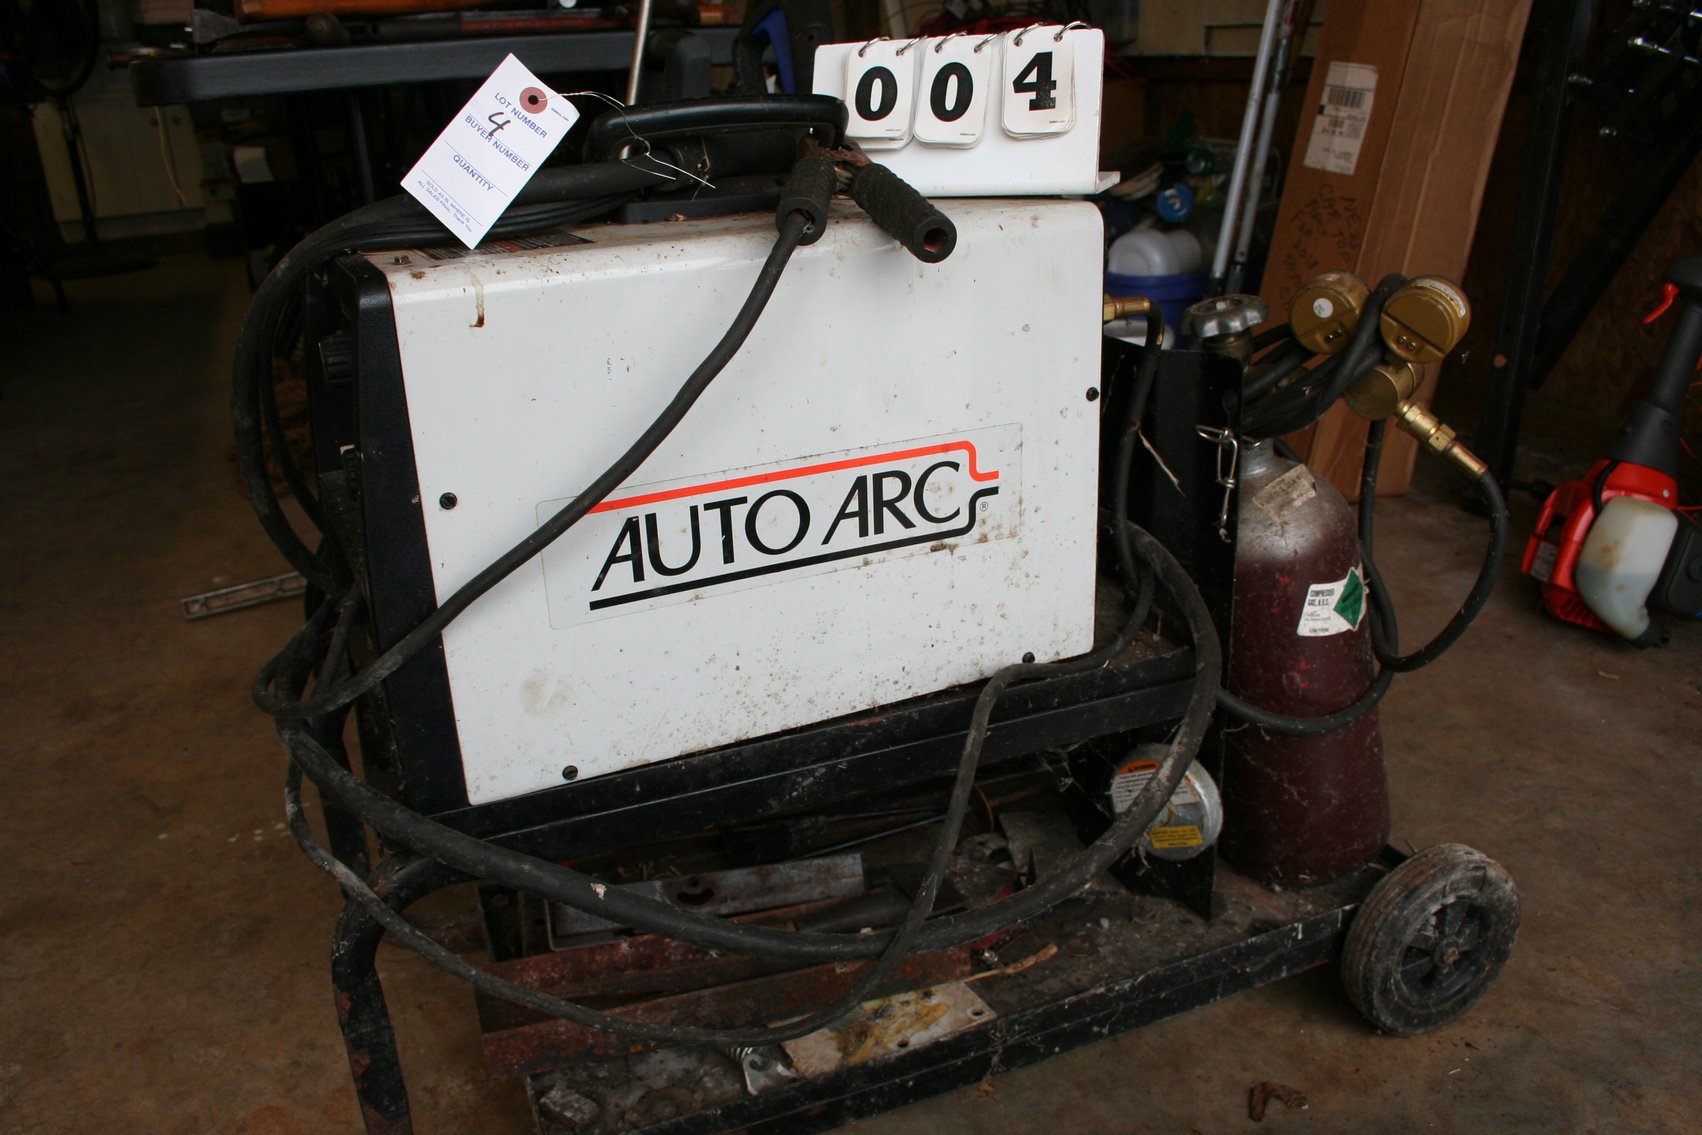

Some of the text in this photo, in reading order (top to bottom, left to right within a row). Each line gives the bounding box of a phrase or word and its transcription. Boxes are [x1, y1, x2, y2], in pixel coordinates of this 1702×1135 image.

[488, 112, 511, 136] 4
[494, 92, 512, 109] LOT
[511, 107, 548, 139] NUMBER
[465, 115, 530, 172] BUYER NUMBER
[453, 154, 494, 192] QUANTITY
[591, 460, 961, 591] AUTO ARC
